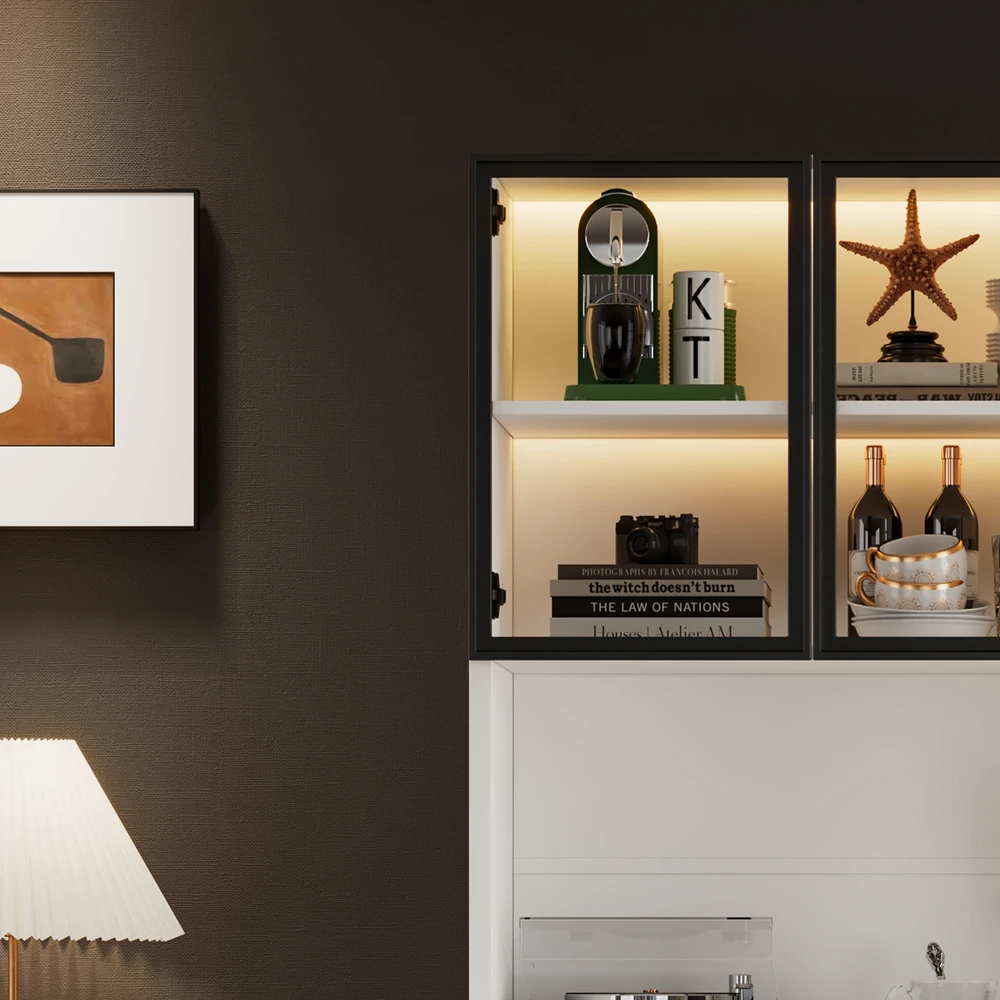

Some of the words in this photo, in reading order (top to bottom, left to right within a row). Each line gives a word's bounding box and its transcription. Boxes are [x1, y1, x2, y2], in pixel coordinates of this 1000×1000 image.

[687, 277, 712, 320] K
[682, 336, 710, 379] T
[582, 568, 646, 577] PHOTOGRAPHS
[648, 568, 658, 577] BY
[659, 568, 702, 578] FRANÇOIS
[703, 568, 739, 577] HALARD
[588, 581, 611, 594] the
[612, 581, 650, 594] witch
[703, 581, 736, 594] burn
[590, 602, 616, 613] THE
[621, 602, 648, 613] LAW
[652, 602, 669, 613] OF
[674, 602, 730, 613] NATIONS
[593, 625, 642, 637] Houses
[656, 625, 703, 637] Atelier
[705, 625, 733, 637] AM
